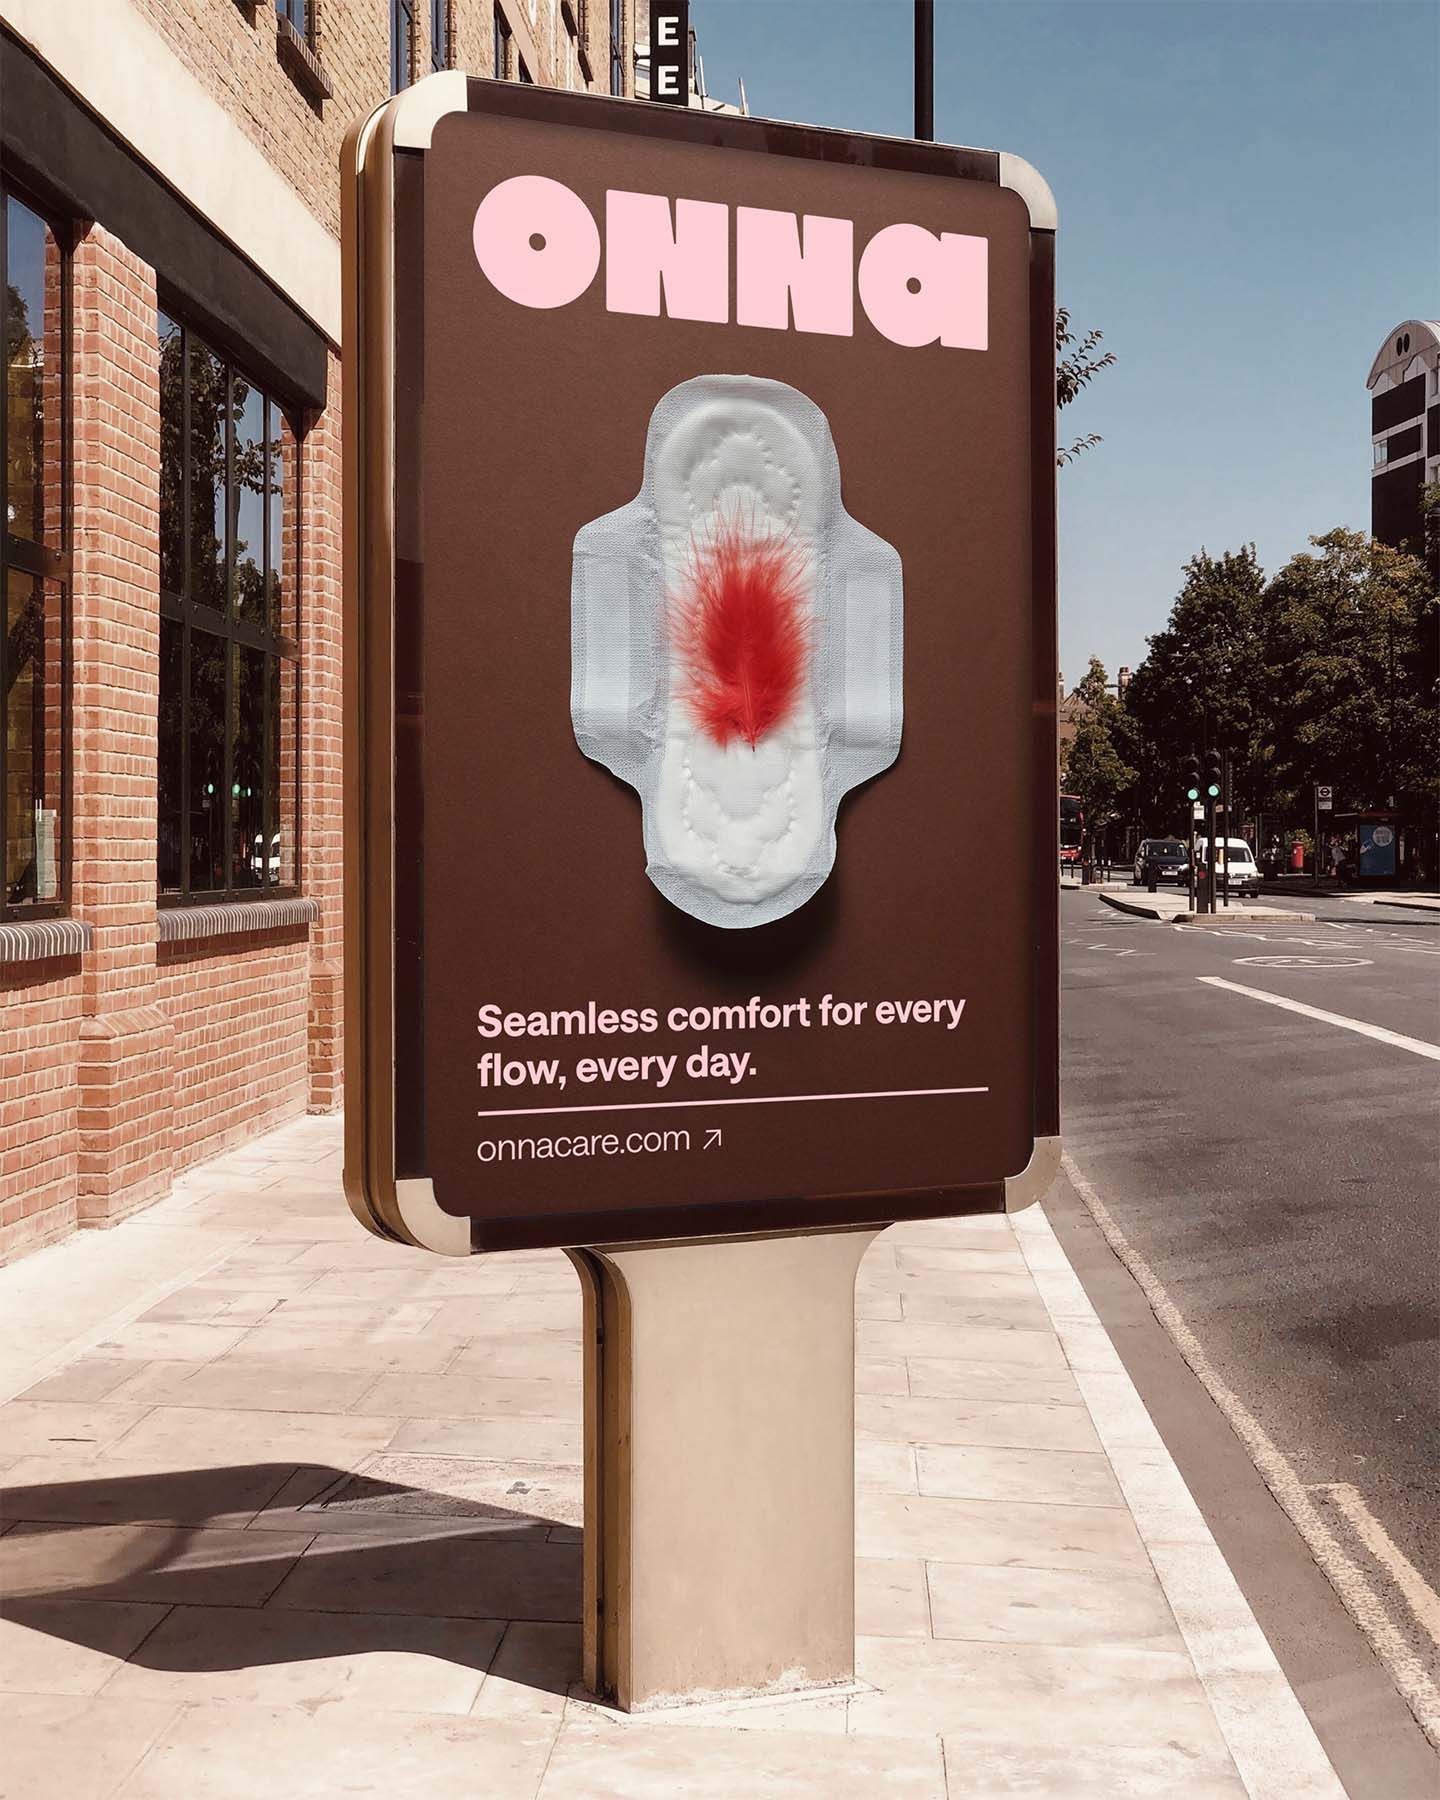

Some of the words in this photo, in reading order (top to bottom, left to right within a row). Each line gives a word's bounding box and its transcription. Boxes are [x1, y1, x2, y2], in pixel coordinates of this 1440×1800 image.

[477, 1001, 658, 1038] Seamless
[667, 996, 811, 1032] comfort
[818, 994, 868, 1026] for
[875, 999, 966, 1030] every
[477, 1052, 567, 1091] flow,
[576, 1055, 678, 1088] every
[686, 1045, 757, 1084] day.
[477, 1129, 690, 1163] onnacare.com
